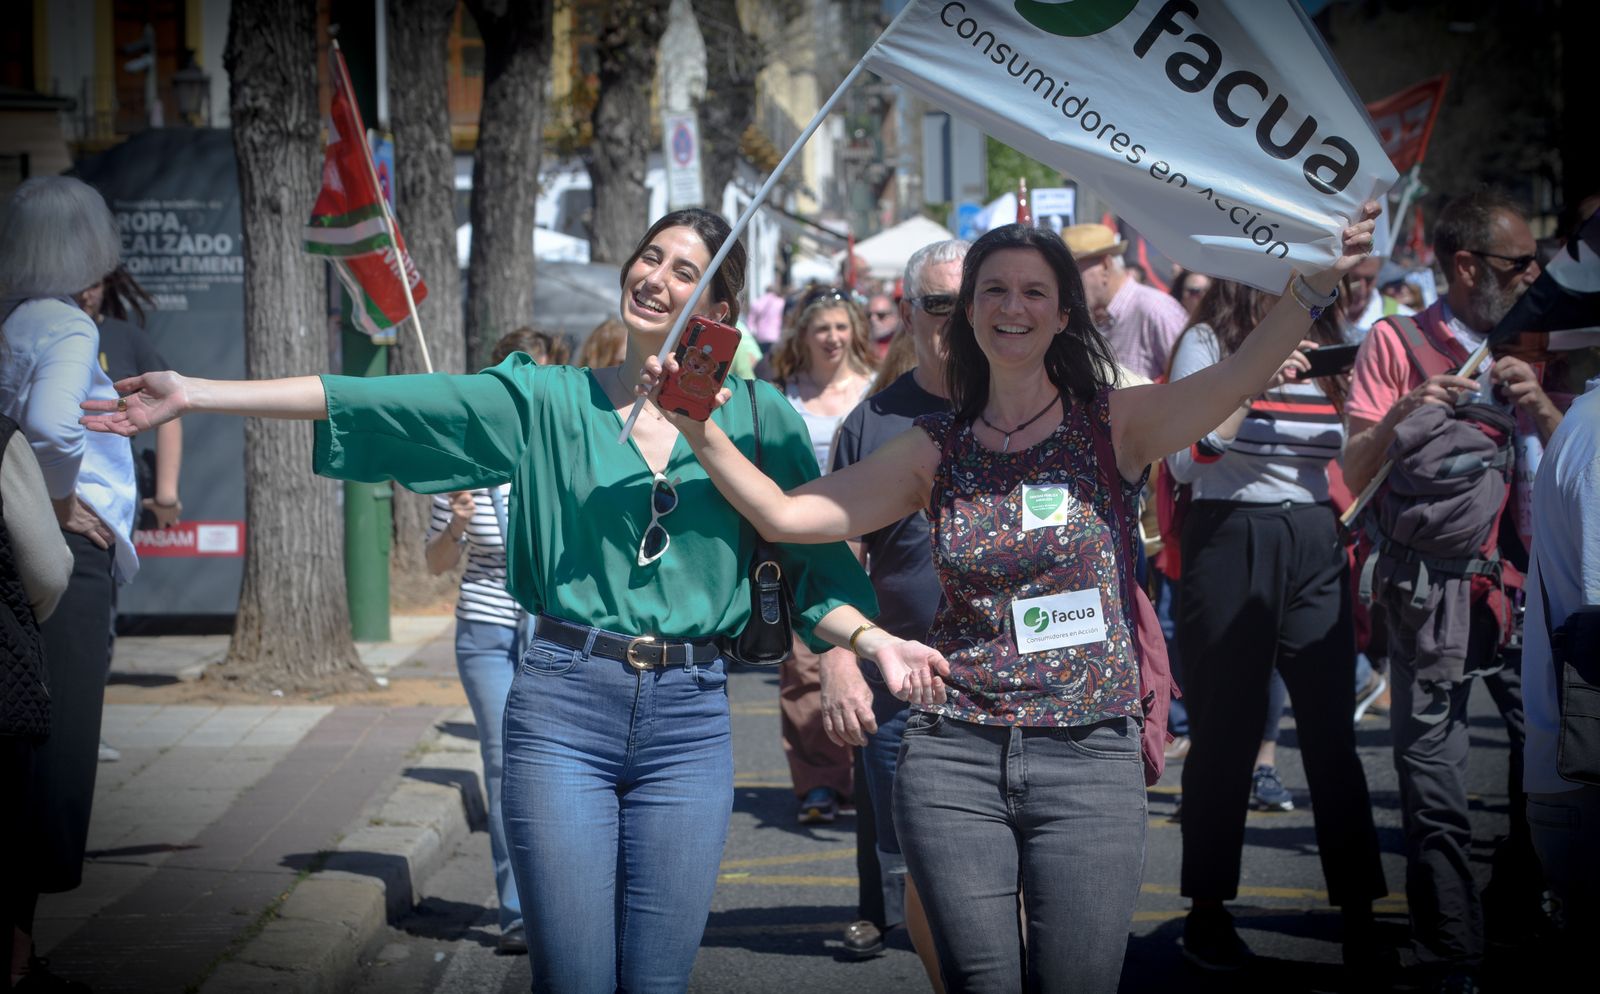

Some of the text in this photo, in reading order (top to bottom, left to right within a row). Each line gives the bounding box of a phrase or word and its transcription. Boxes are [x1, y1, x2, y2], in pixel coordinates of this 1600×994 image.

[940, 1, 1147, 164] Consumidores
[1149, 160, 1188, 188] en
[1133, 0, 1360, 195] facua
[1026, 632, 1069, 644] Consumidores
[1078, 627, 1098, 636] Acción
[1051, 607, 1095, 623] facua
